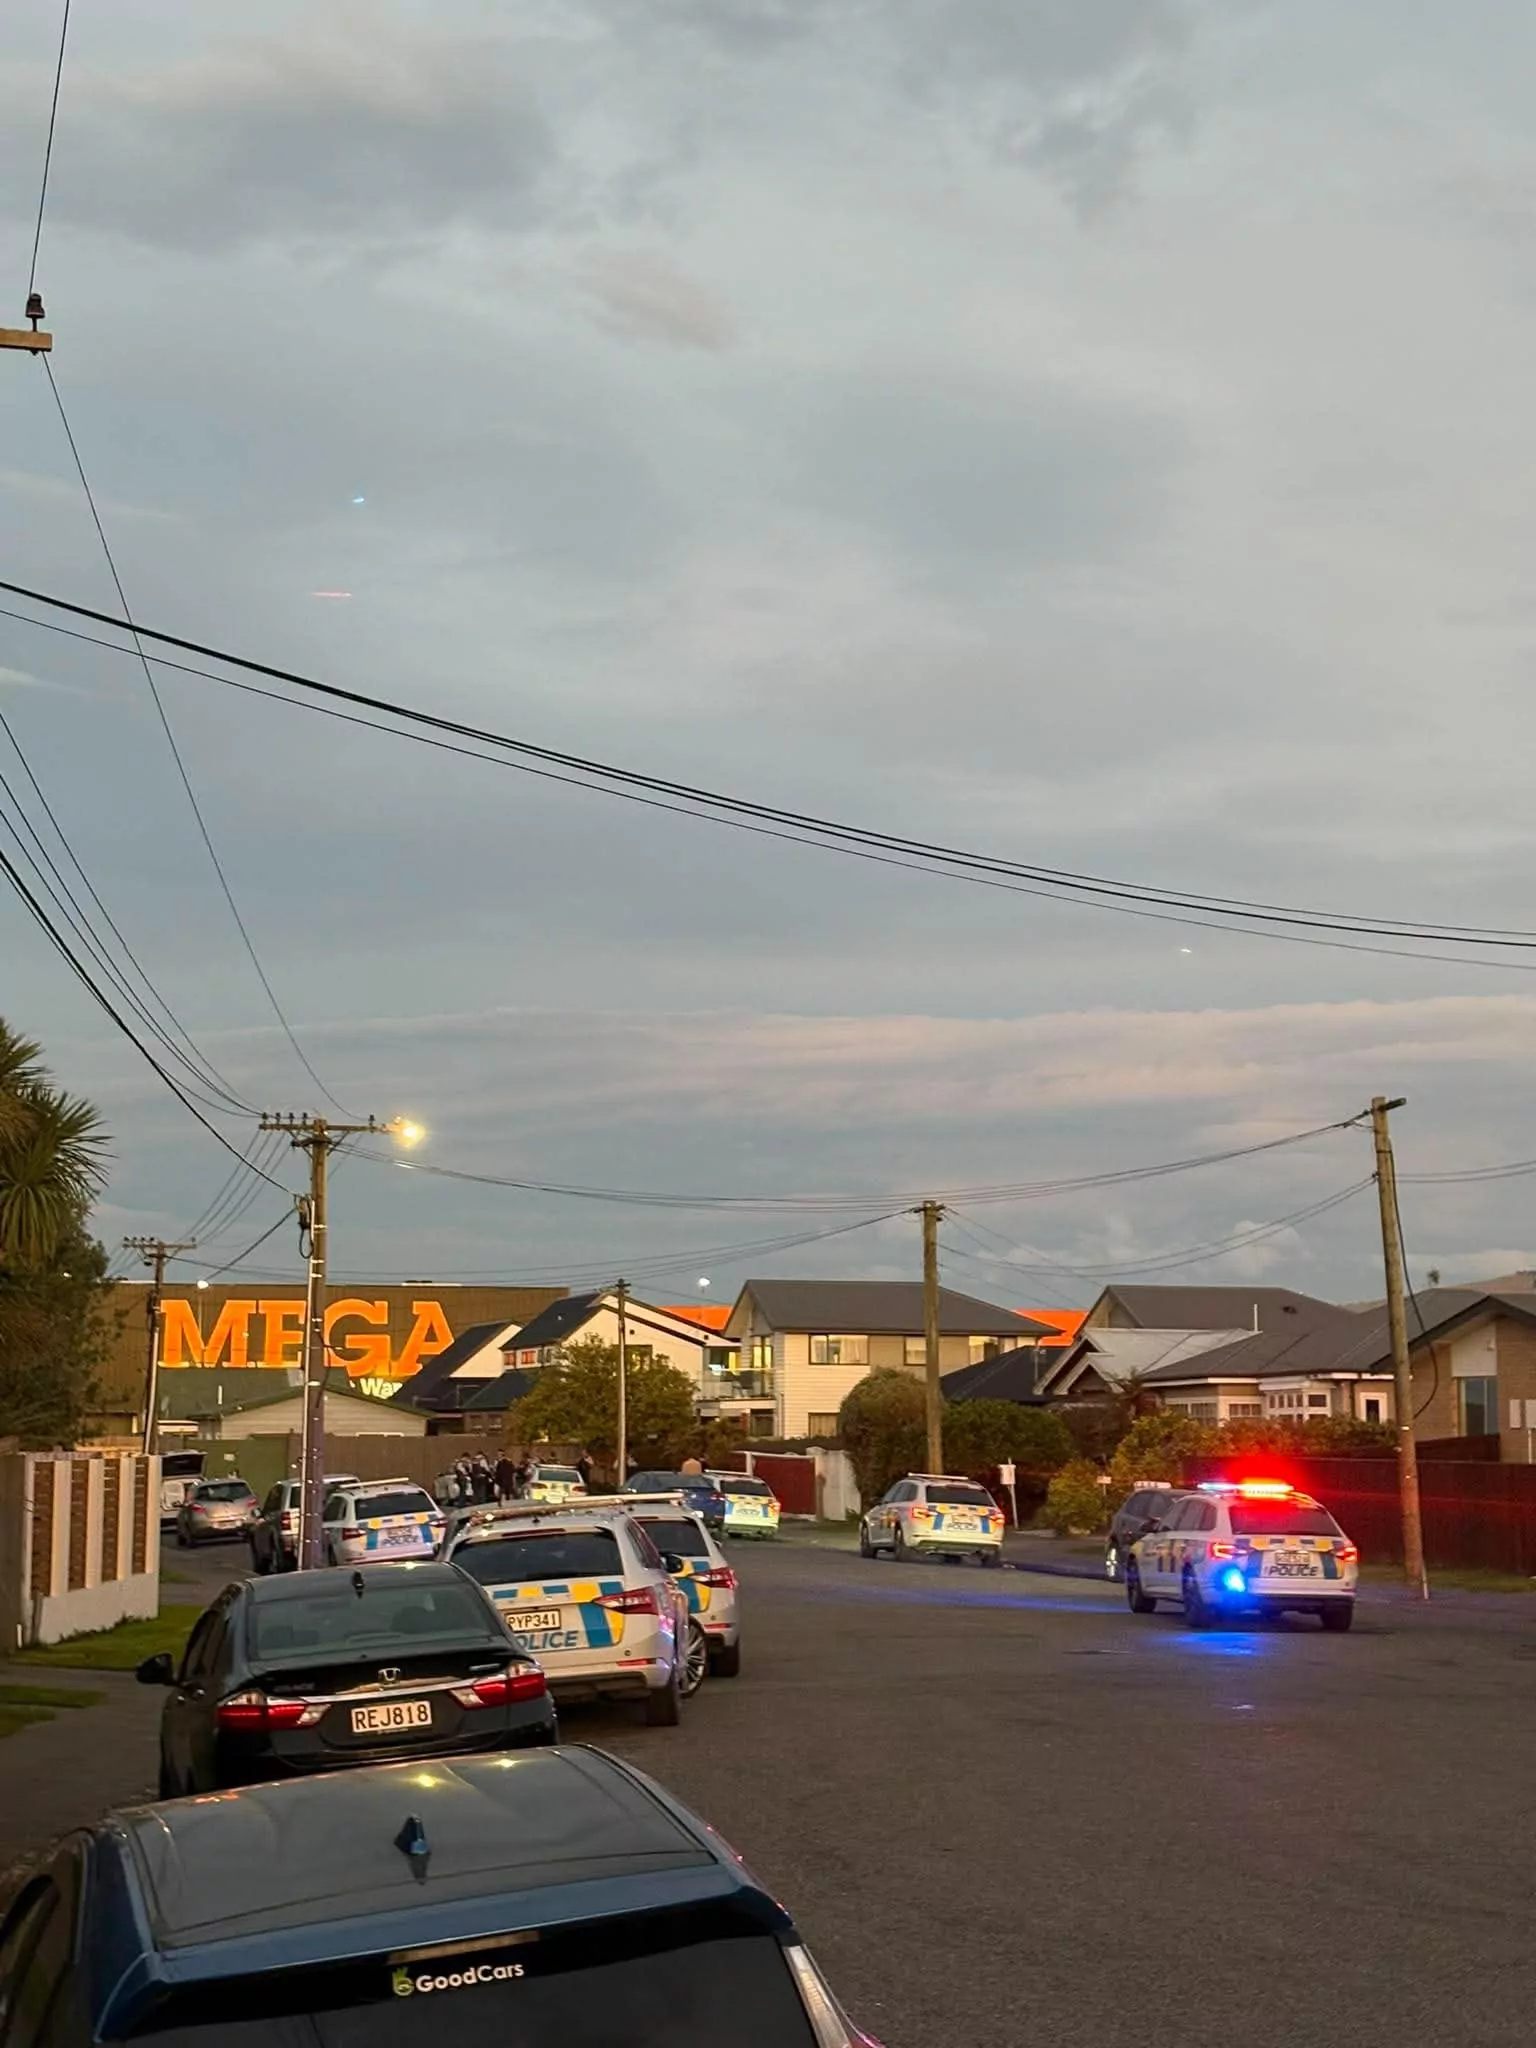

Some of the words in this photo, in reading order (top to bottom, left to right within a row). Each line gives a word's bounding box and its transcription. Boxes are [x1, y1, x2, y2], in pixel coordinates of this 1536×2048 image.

[158, 1298, 455, 1377] MEGA
[1268, 1565, 1318, 1577] POLICE
[508, 1613, 556, 1628] PYP341
[516, 1630, 579, 1650] OLICE
[354, 1706, 429, 1730] REJ818
[415, 1963, 525, 1992] GoodCars
